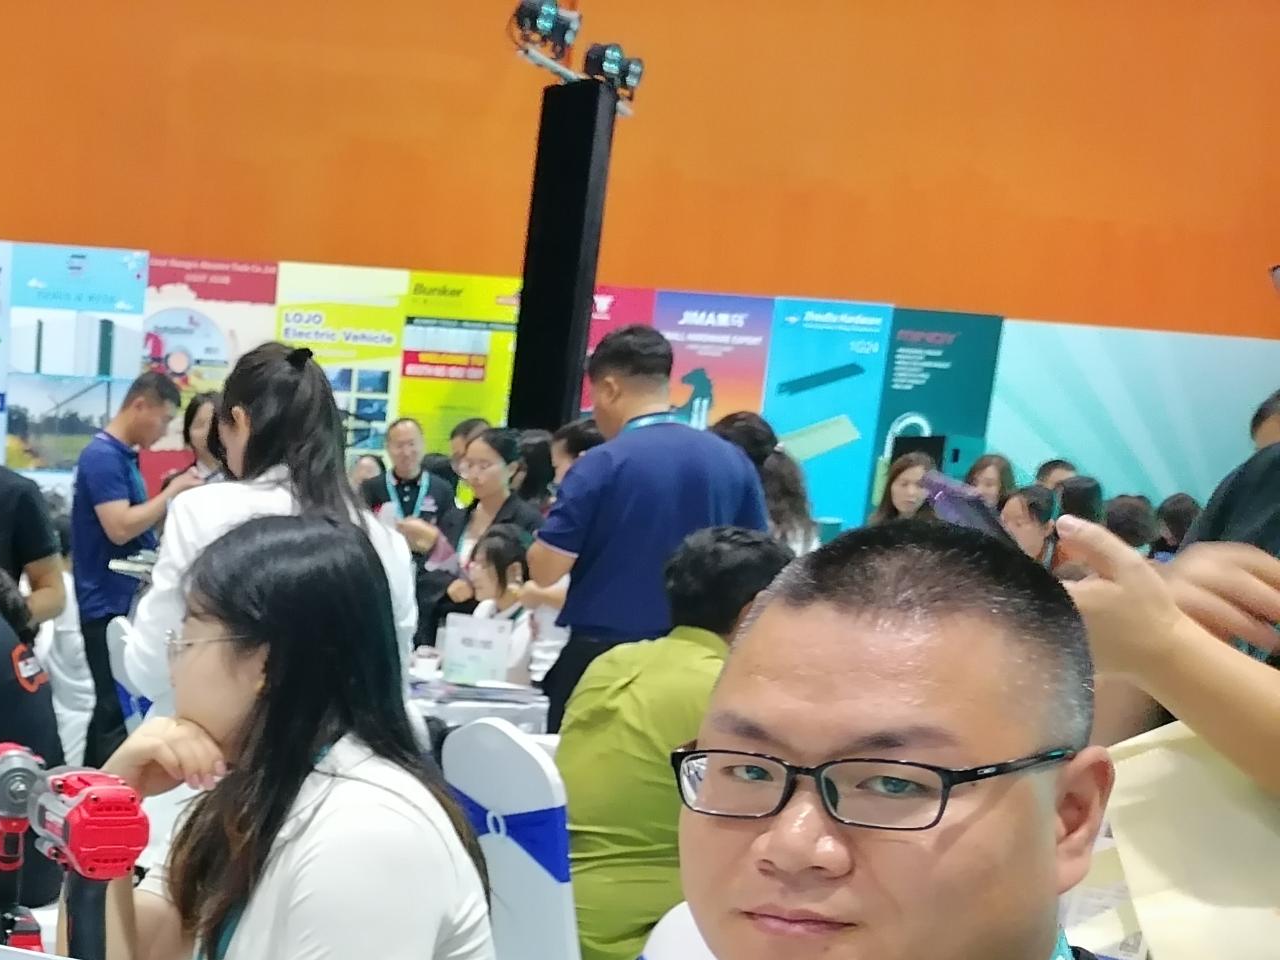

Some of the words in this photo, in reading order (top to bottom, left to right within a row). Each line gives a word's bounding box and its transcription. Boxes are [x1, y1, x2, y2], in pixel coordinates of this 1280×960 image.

[412, 283, 464, 297] Bunker
[284, 312, 323, 325] LOJO
[283, 328, 337, 342] Electric
[343, 331, 394, 345] Vehicle
